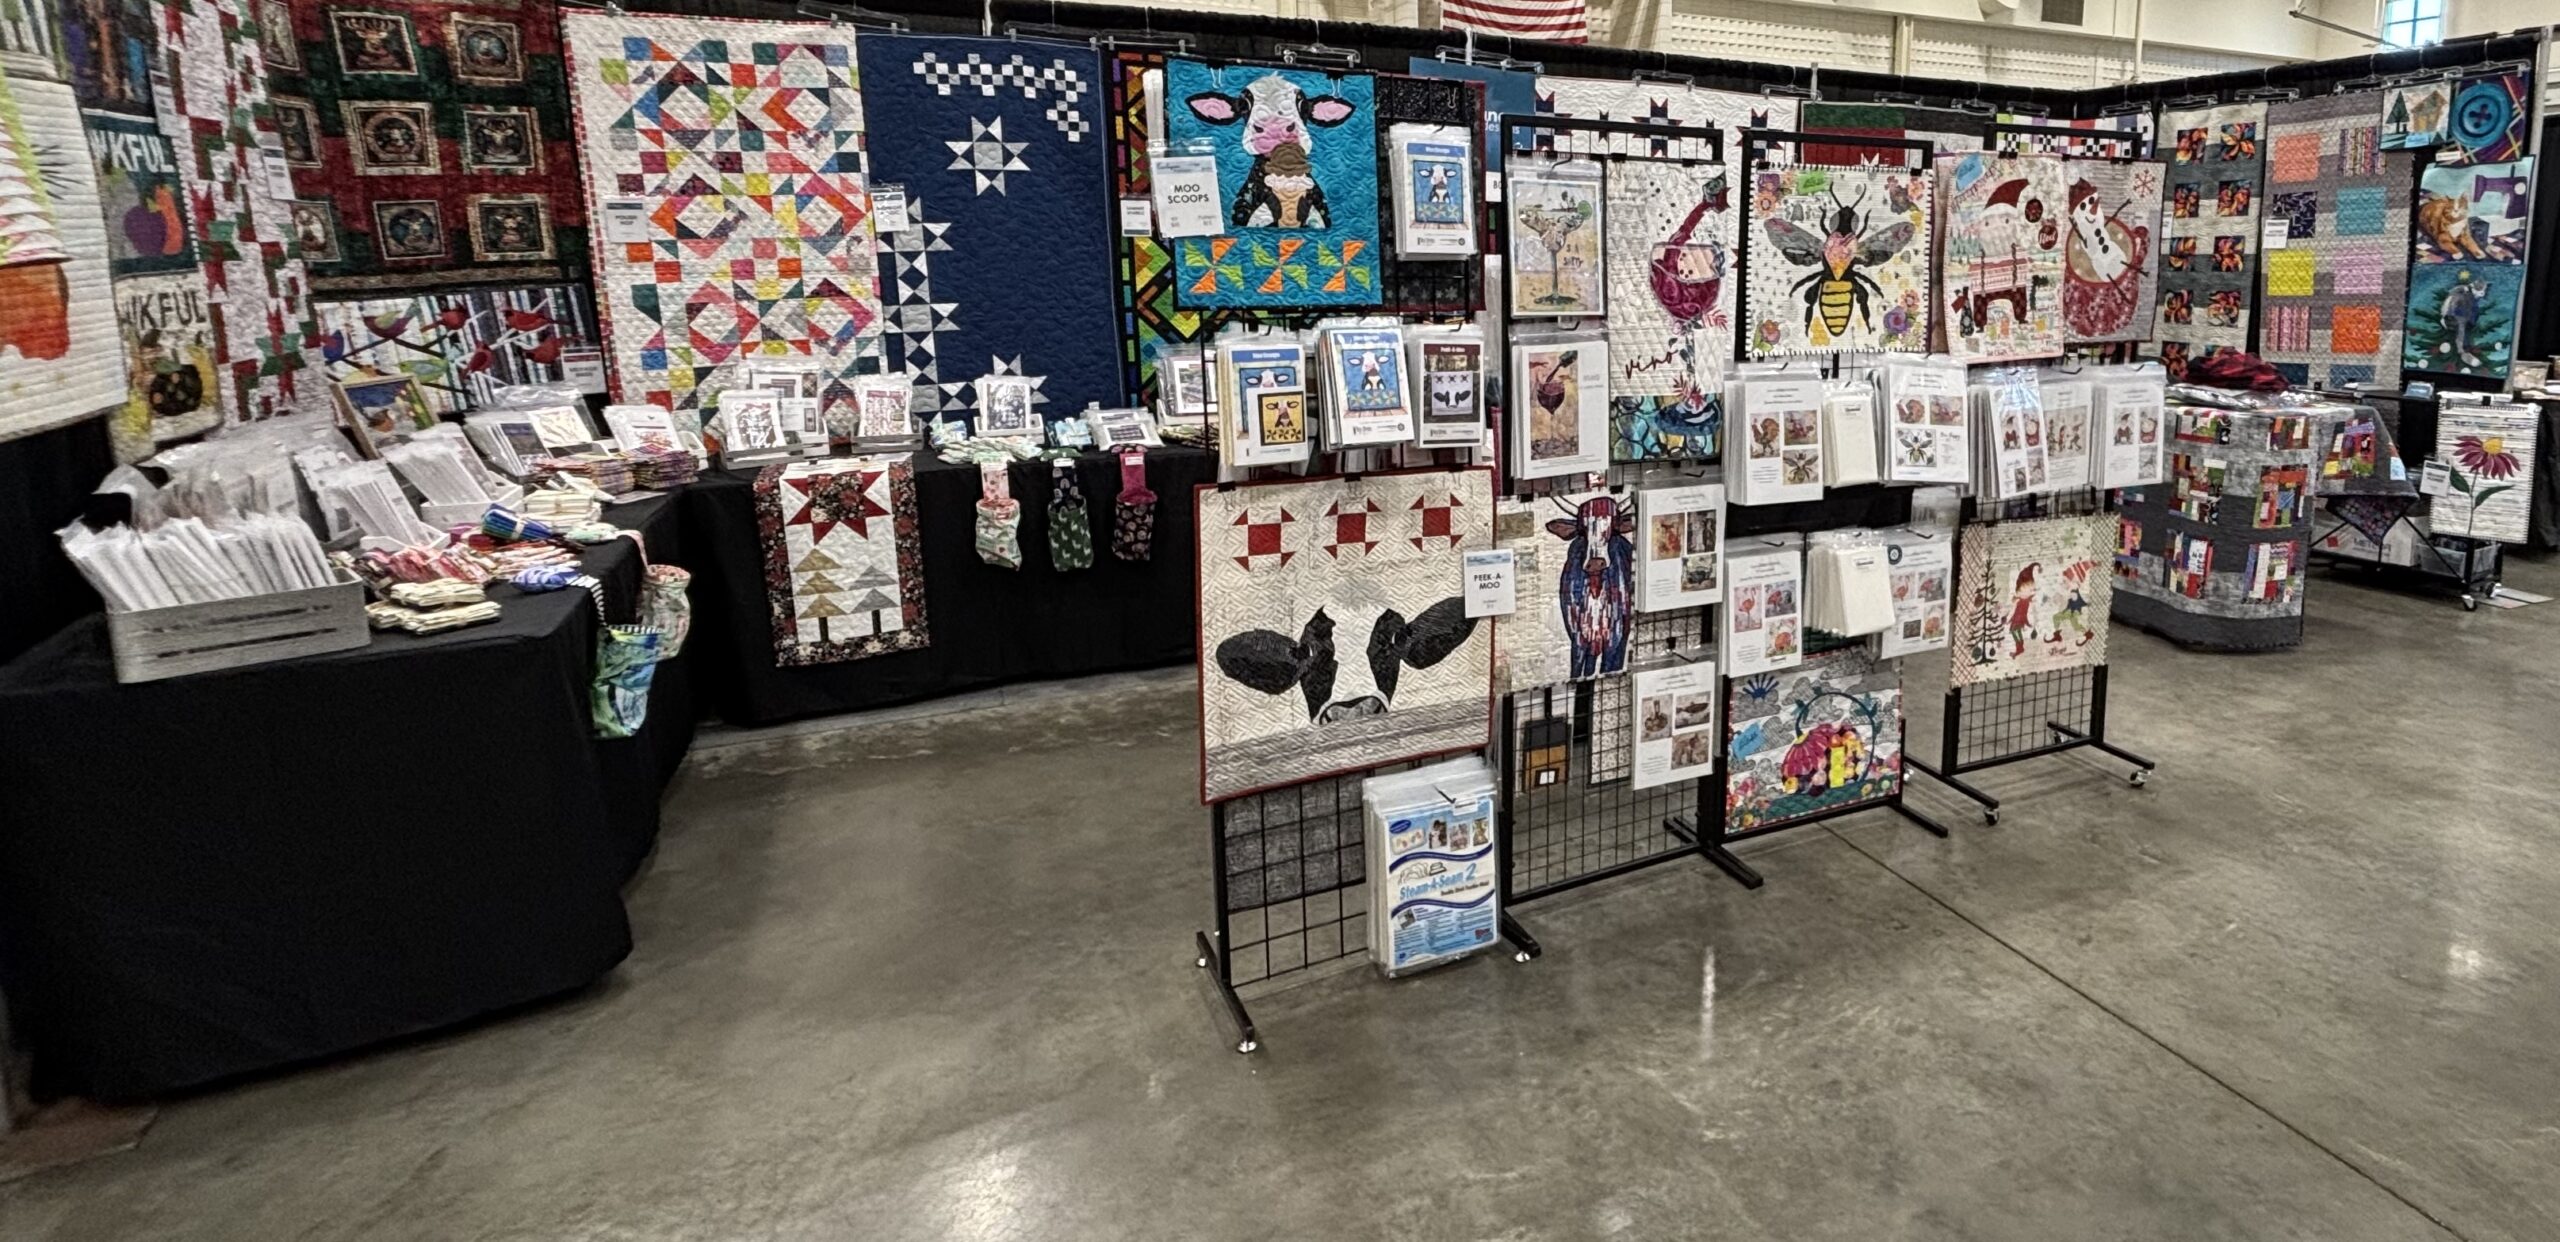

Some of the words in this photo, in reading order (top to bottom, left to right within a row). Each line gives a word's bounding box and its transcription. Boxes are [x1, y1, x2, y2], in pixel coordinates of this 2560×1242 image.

[1174, 183, 1200, 193] MOO
[1167, 193, 1210, 205] SCOOPS
[1625, 349, 1679, 380] vino
[1479, 581, 1501, 590] MOO
[1466, 862, 1477, 881] 2
